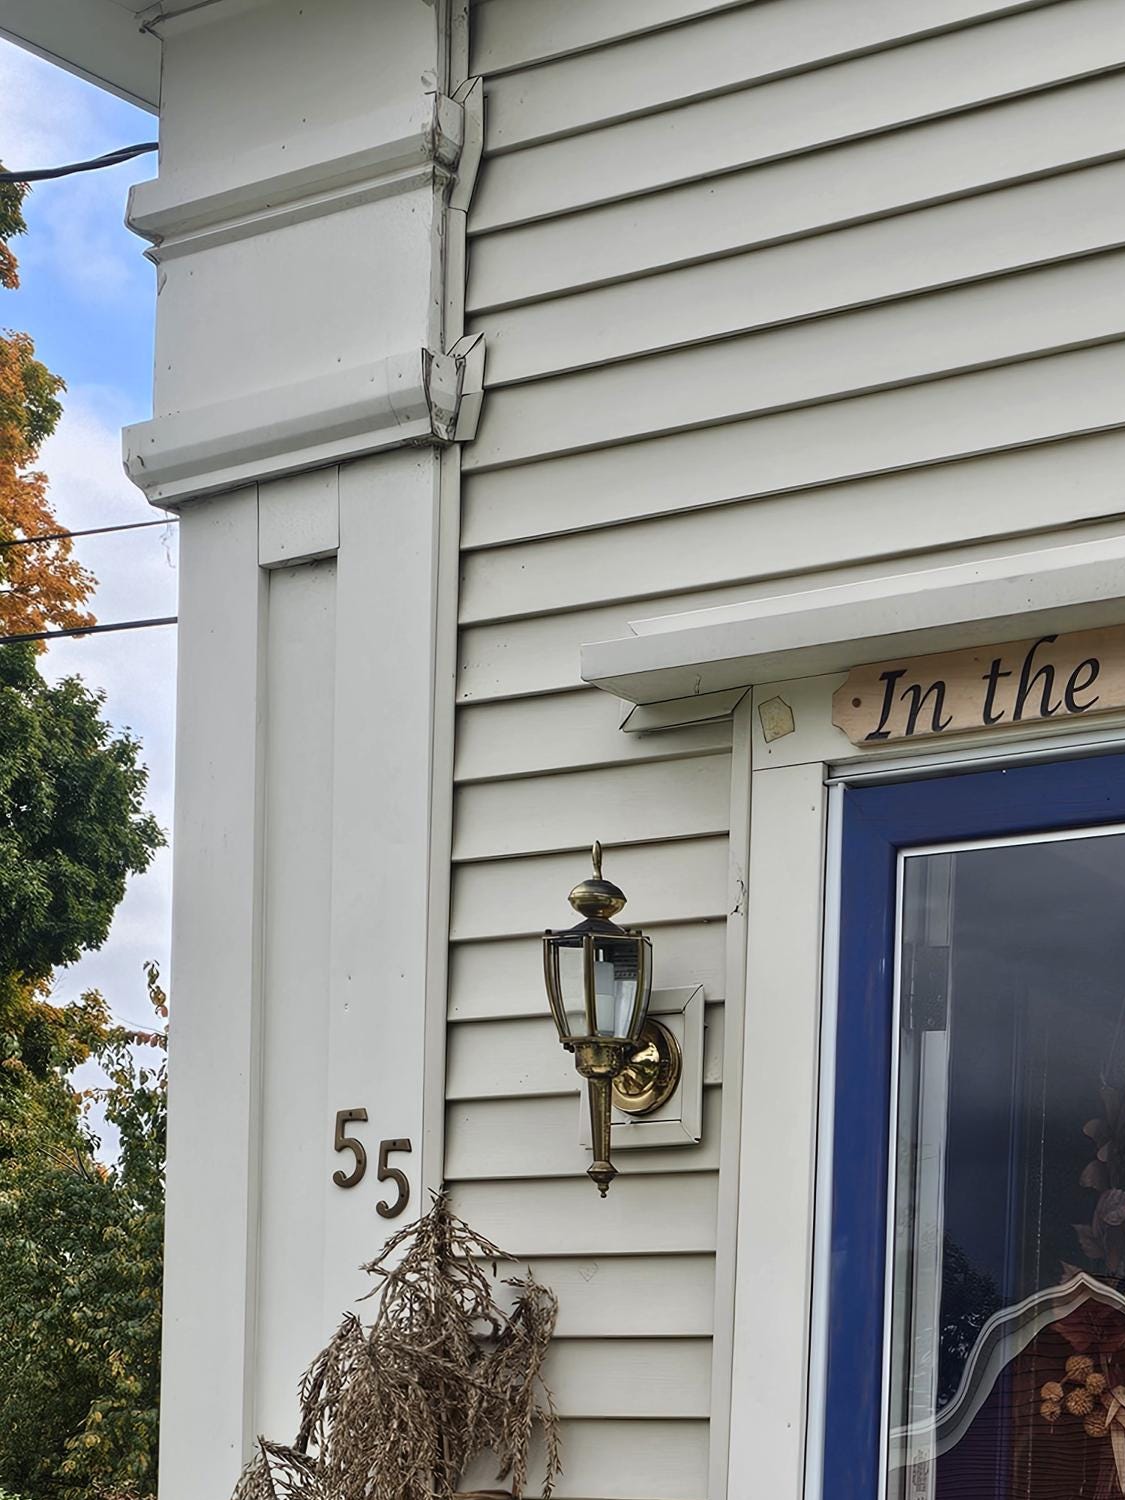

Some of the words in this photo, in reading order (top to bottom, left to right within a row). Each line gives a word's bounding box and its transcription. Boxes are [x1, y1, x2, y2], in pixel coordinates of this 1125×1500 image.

[864, 669, 953, 741] In
[982, 634, 1100, 726] the
[332, 1107, 412, 1219] 55
